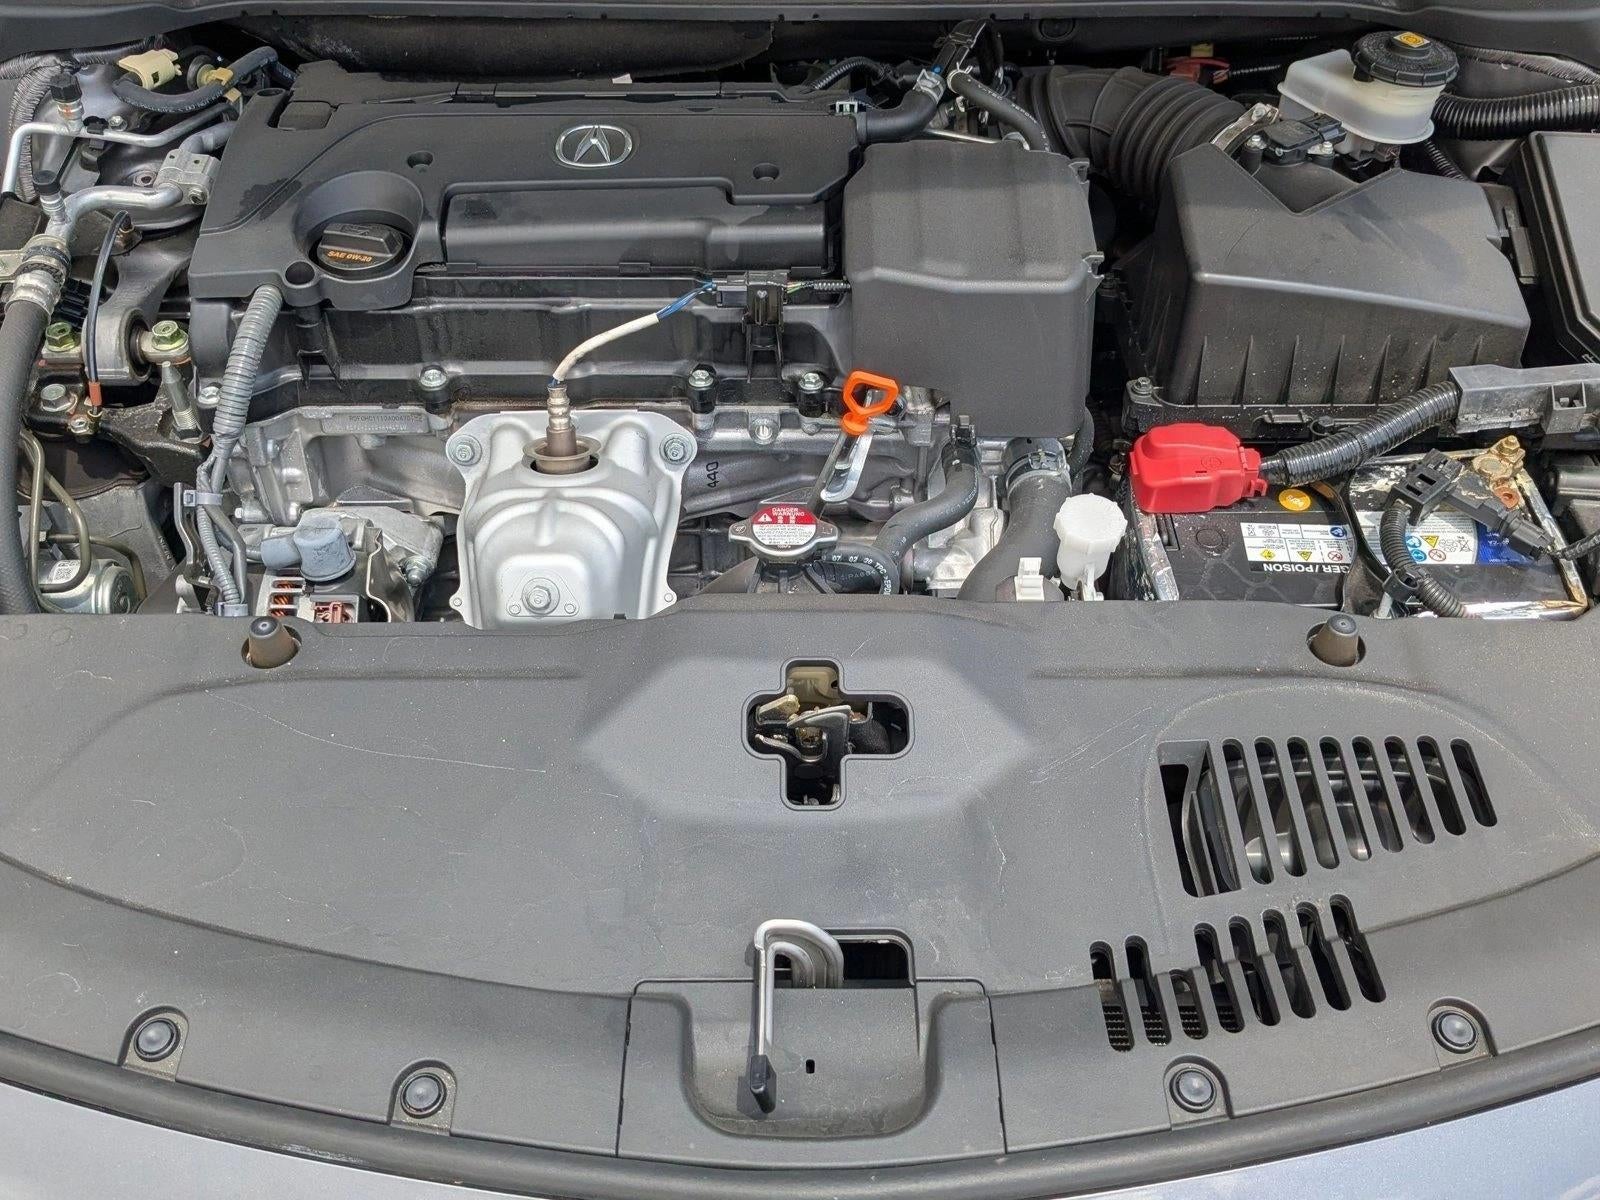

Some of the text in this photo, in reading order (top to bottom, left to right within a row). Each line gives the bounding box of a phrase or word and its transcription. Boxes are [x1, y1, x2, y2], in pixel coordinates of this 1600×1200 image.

[327, 250, 372, 262] SAE 0W-20
[705, 461, 719, 488] 440
[1263, 563, 1315, 573] POISON
